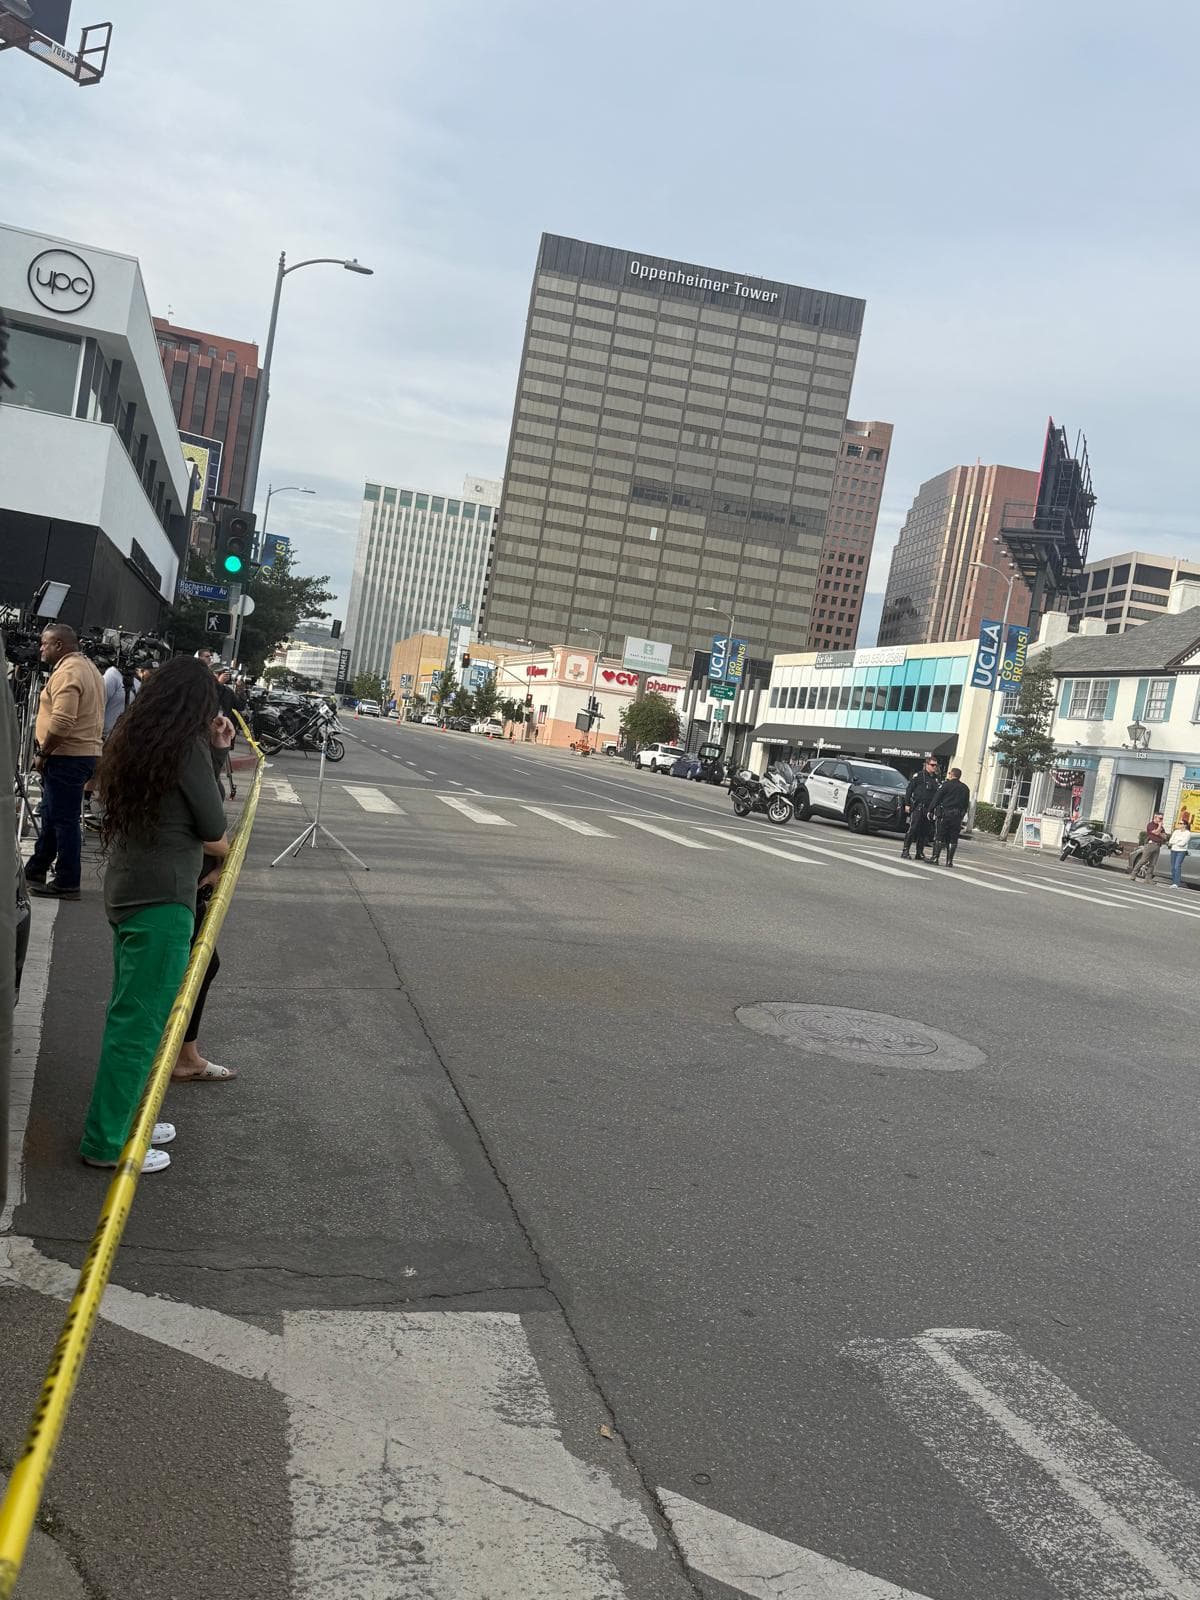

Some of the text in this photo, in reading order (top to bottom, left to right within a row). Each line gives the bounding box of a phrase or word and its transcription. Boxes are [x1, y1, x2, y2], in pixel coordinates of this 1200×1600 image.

[36, 266, 89, 295] upc
[630, 260, 778, 303] Oppenheimer Tower
[180, 580, 228, 596] Rochester Av
[710, 639, 727, 678] UCLA
[728, 661, 736, 675] GO
[735, 643, 746, 676] BRUINS!
[974, 624, 1001, 686] UCLA
[1001, 659, 1014, 681] GO
[1012, 631, 1029, 682] BRUINS!
